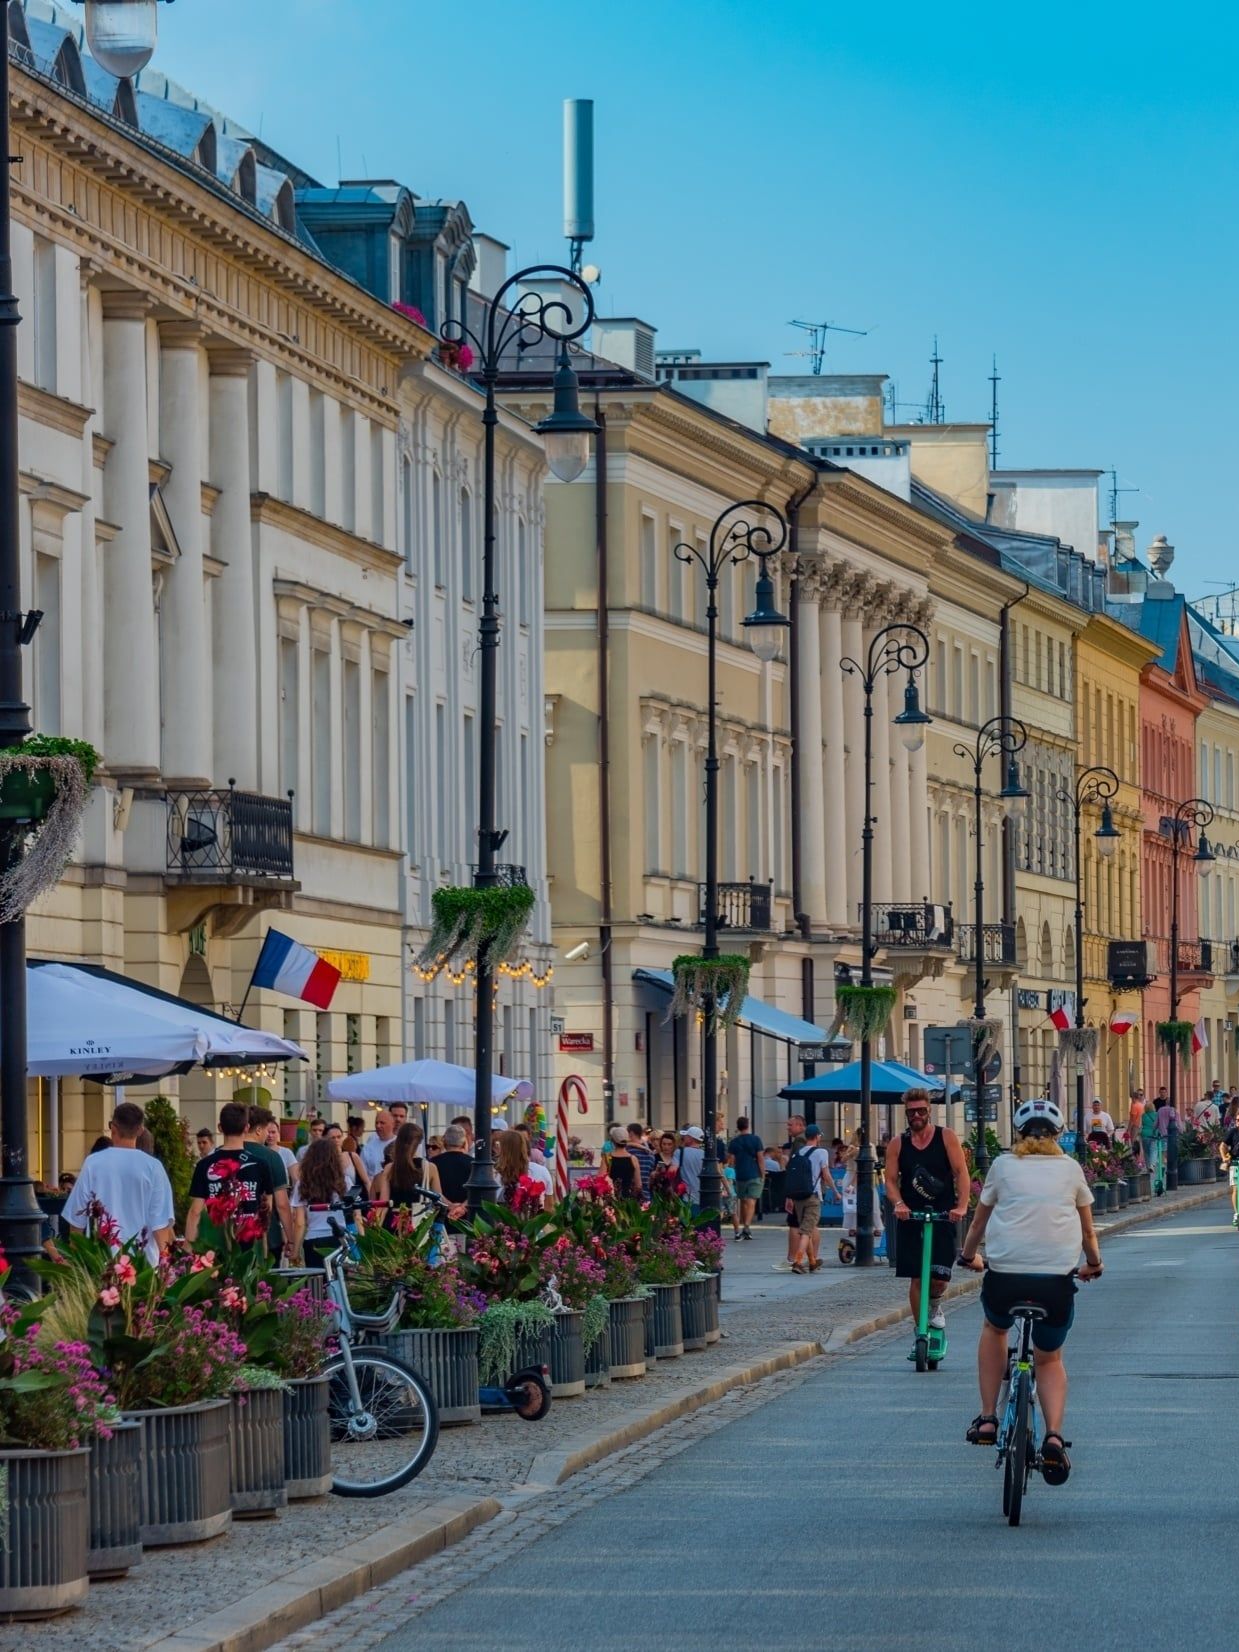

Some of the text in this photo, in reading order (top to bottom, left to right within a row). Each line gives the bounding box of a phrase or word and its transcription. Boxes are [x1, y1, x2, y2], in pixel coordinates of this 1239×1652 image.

[553, 1023, 562, 1032] 51
[561, 1036, 592, 1046] Warecka
[69, 1046, 112, 1055] KINLEY
[208, 1181, 258, 1194] SWSH
